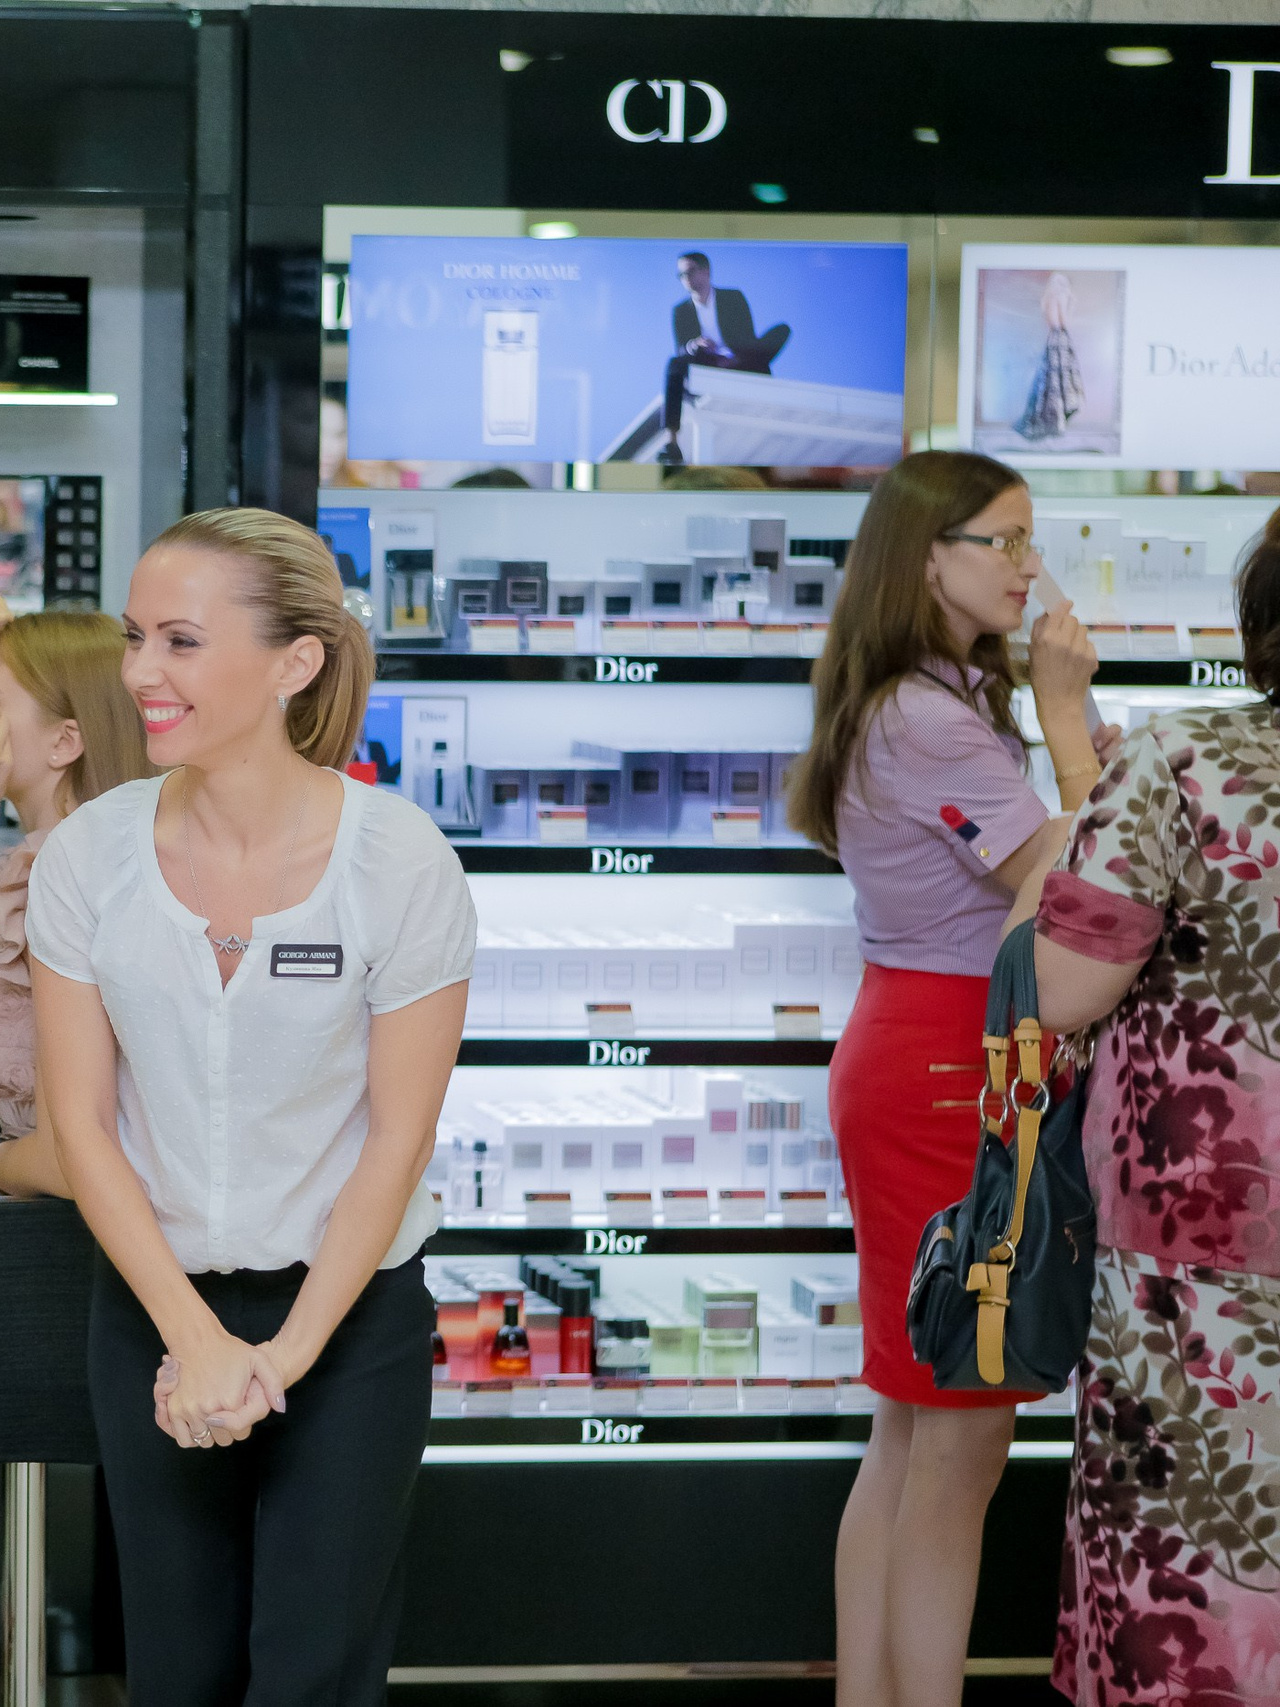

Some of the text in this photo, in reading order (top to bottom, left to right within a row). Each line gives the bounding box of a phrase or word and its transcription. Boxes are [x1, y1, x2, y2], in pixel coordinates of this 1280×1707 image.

[606, 78, 728, 143] CD
[443, 263, 581, 281] DIOR HOMME
[1146, 343, 1220, 377] Dior
[594, 656, 658, 682] Dior
[590, 847, 654, 873] Dior
[278, 951, 308, 959] GIORGIO
[587, 1040, 651, 1066] Dior
[584, 1229, 648, 1255] Dior
[580, 1418, 644, 1443] Dior
